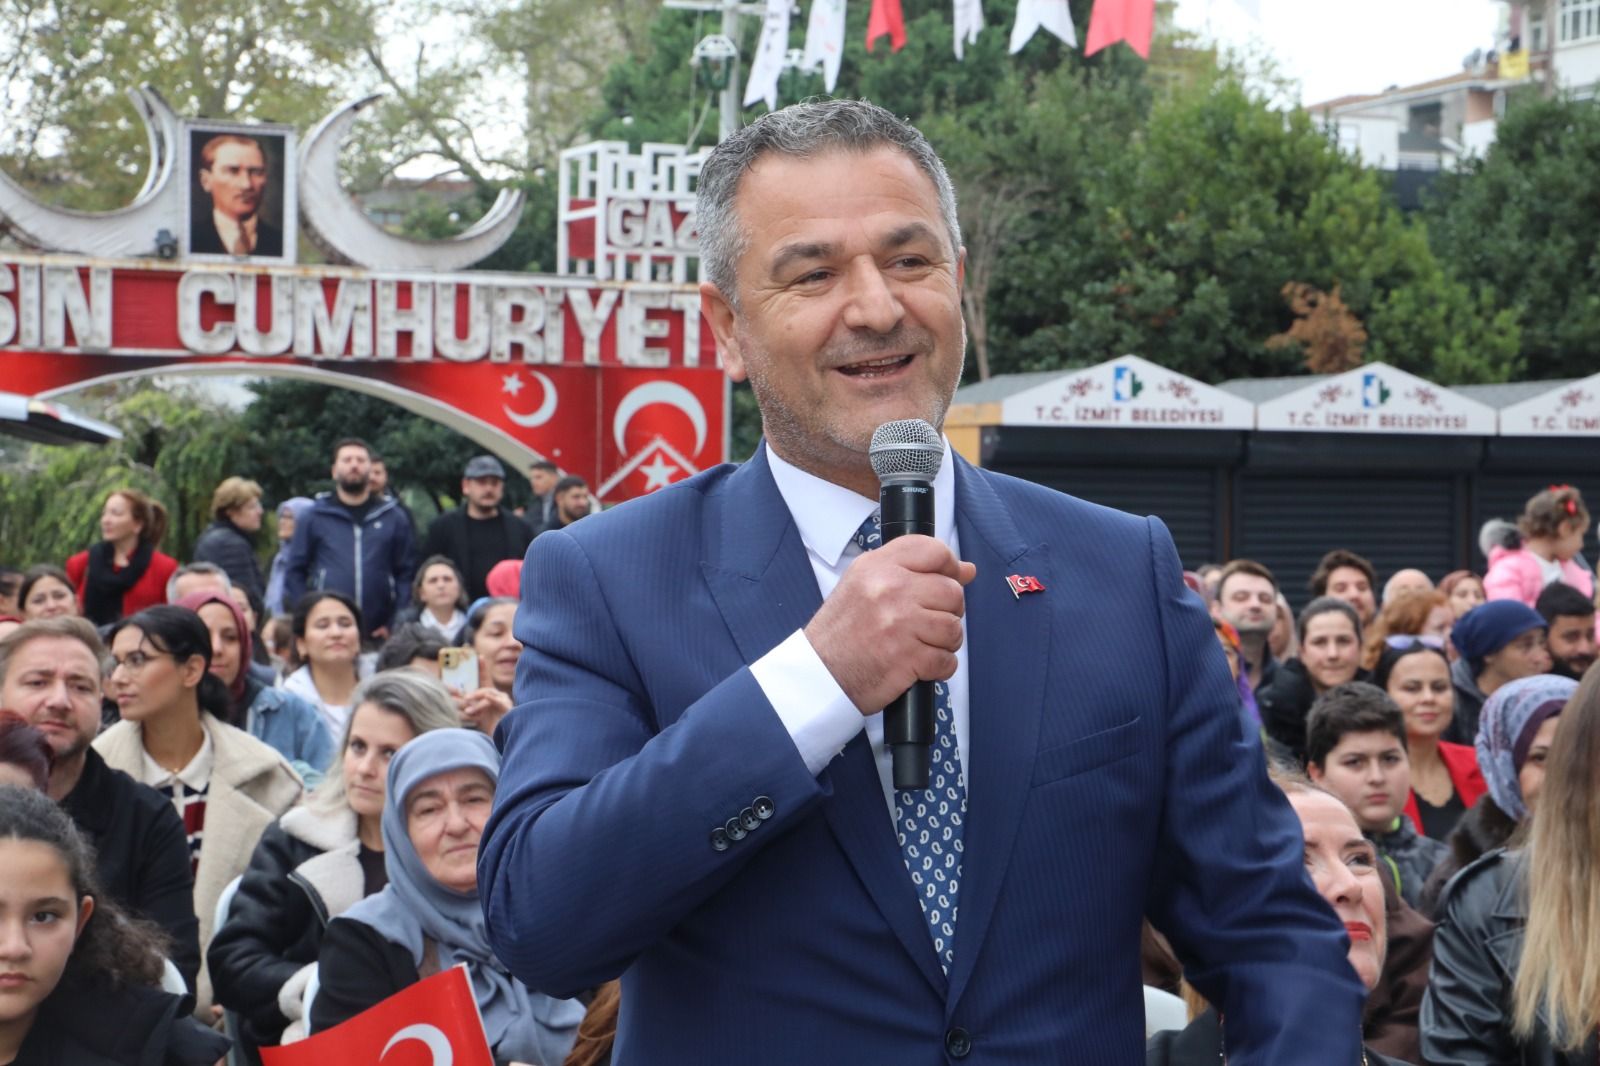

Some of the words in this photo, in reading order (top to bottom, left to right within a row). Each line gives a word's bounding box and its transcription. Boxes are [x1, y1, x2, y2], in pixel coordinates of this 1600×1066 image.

[1075, 406, 1121, 422] İZMİT
[1131, 407, 1224, 423] BELEDİYESİ
[1378, 414, 1467, 429] BELEDİYESİ
[901, 486, 928, 494] SHURE
